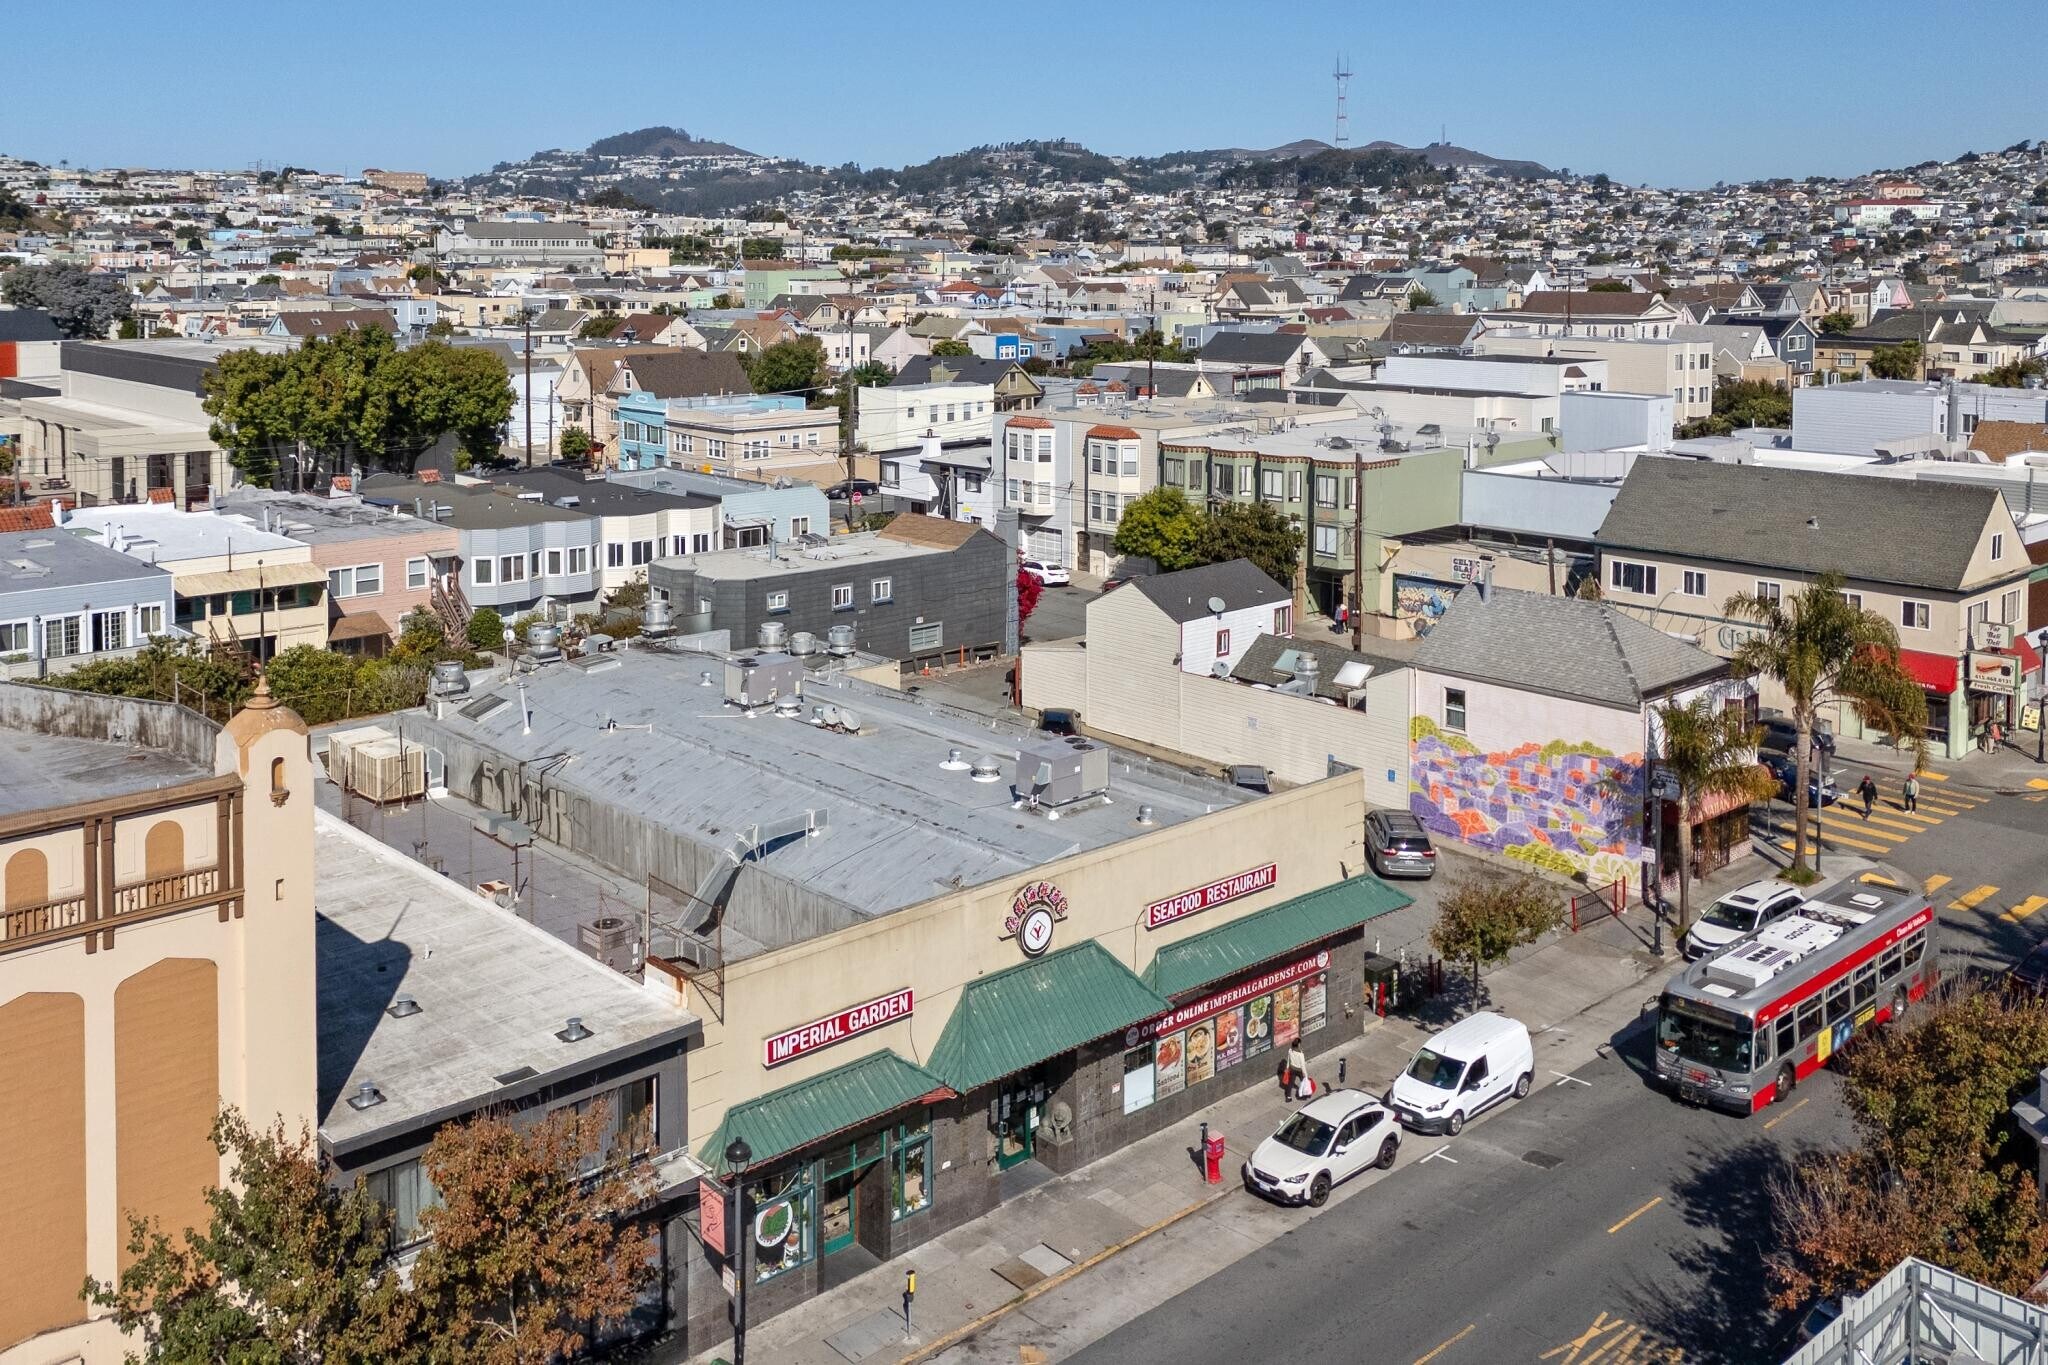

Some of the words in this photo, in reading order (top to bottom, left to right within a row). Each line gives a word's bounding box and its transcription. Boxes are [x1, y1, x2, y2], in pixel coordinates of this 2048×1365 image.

[1453, 558, 1480, 568] CELTC
[1153, 893, 1202, 921] SEAFOOD
[1206, 866, 1273, 904] RESTAURANT
[772, 1017, 845, 1060] IMPERIAL
[848, 993, 909, 1031] GARDEN
[1141, 1015, 1174, 1037] ORDER
[1176, 1003, 1209, 1023] ONLINE
[1209, 958, 1316, 1010] IMPERIALGARDENSF.COM
